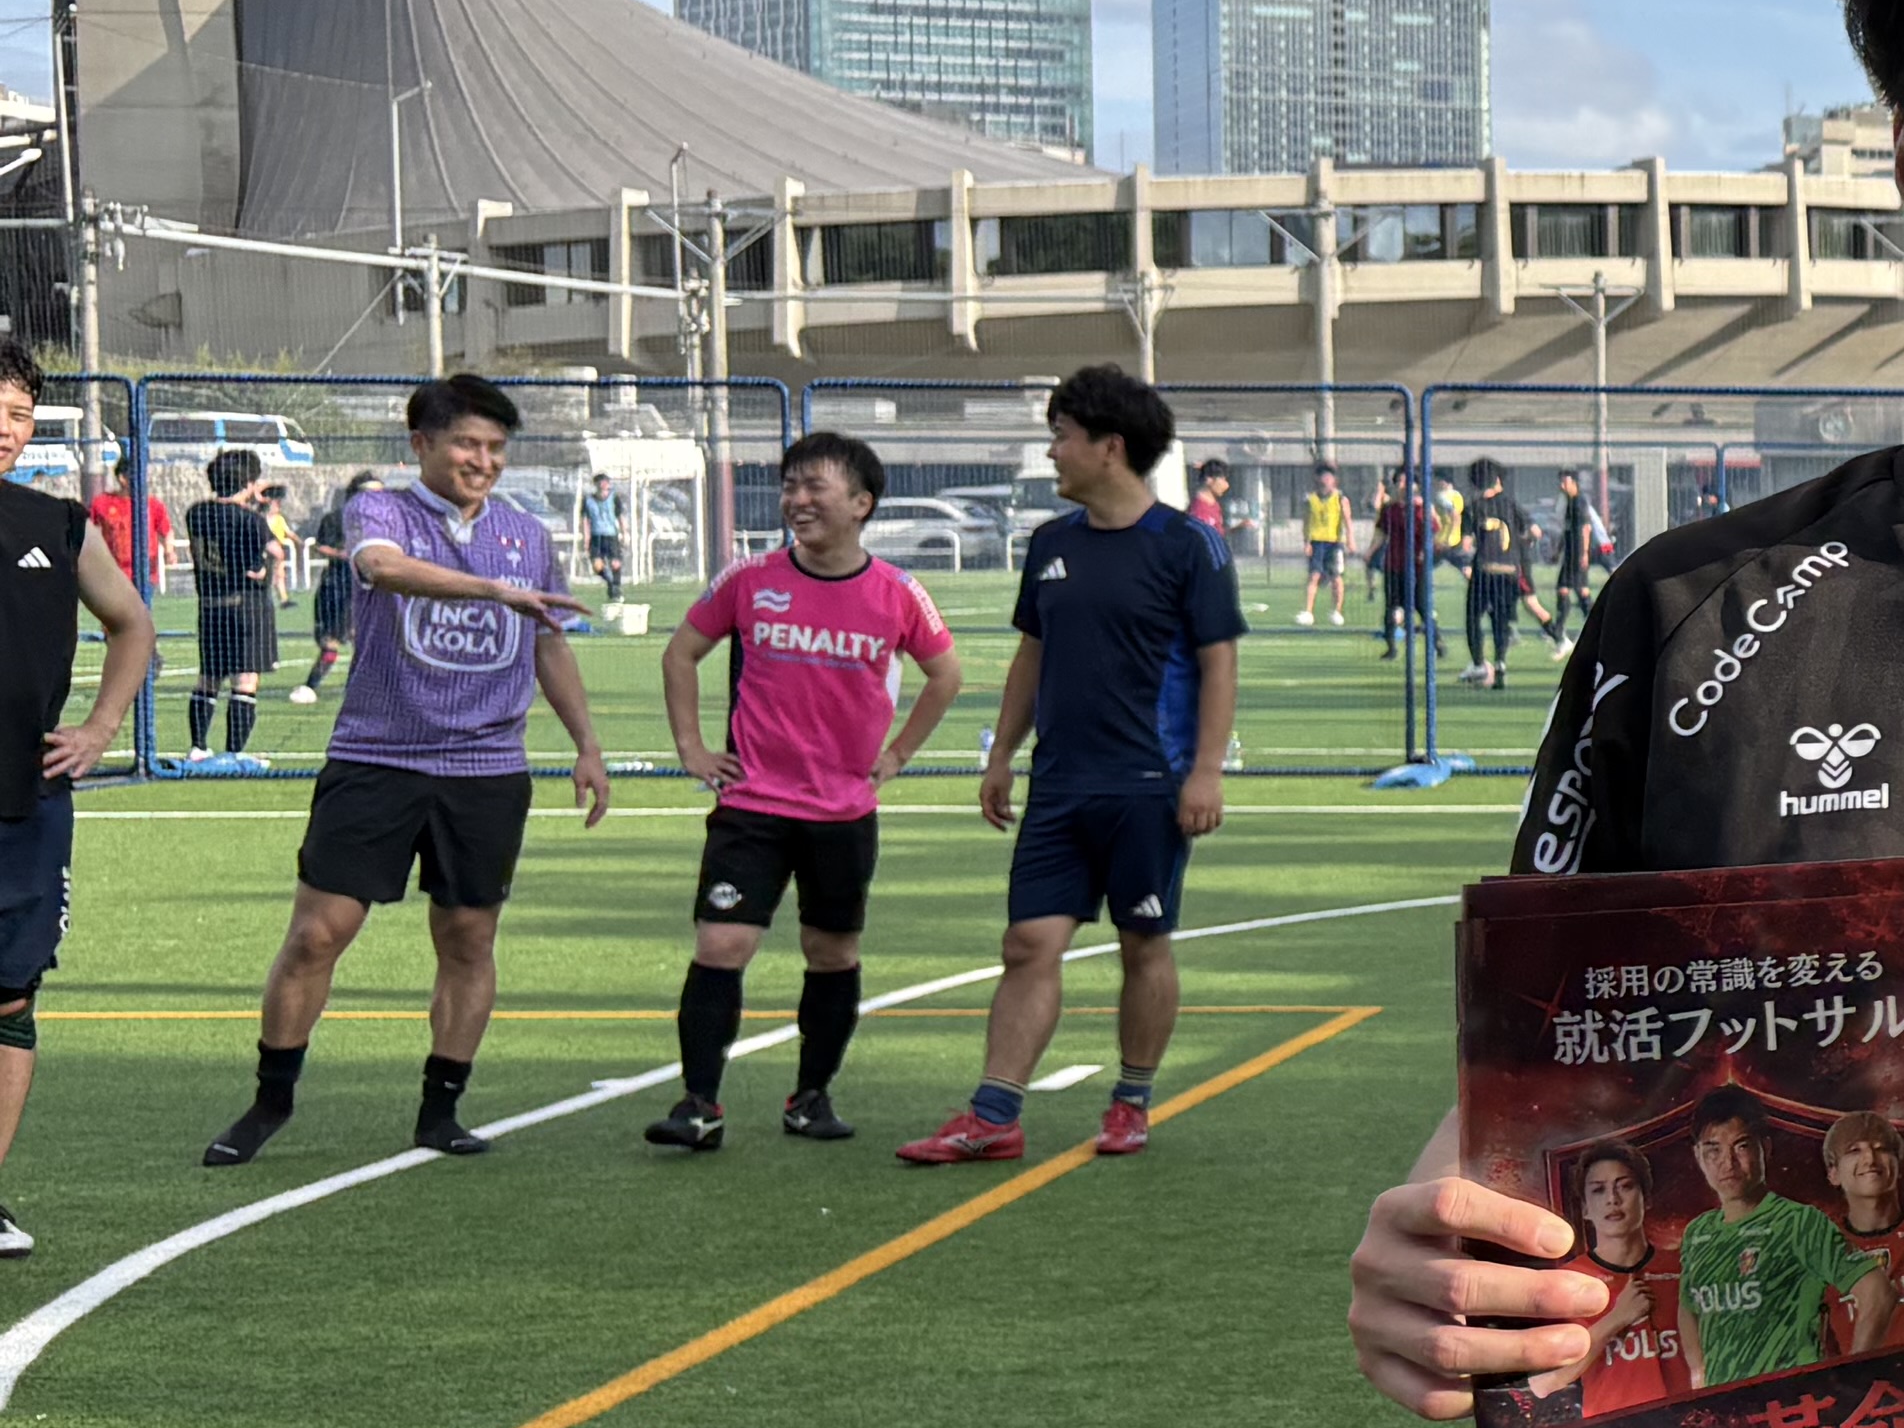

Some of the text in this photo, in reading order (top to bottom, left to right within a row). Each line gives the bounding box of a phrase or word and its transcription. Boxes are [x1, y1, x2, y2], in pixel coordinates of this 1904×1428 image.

[430, 601, 498, 632] INCA
[753, 622, 887, 663] PENALTY
[1780, 783, 1889, 817] hummel
[1584, 950, 1884, 1000] 採用の常識を変える
